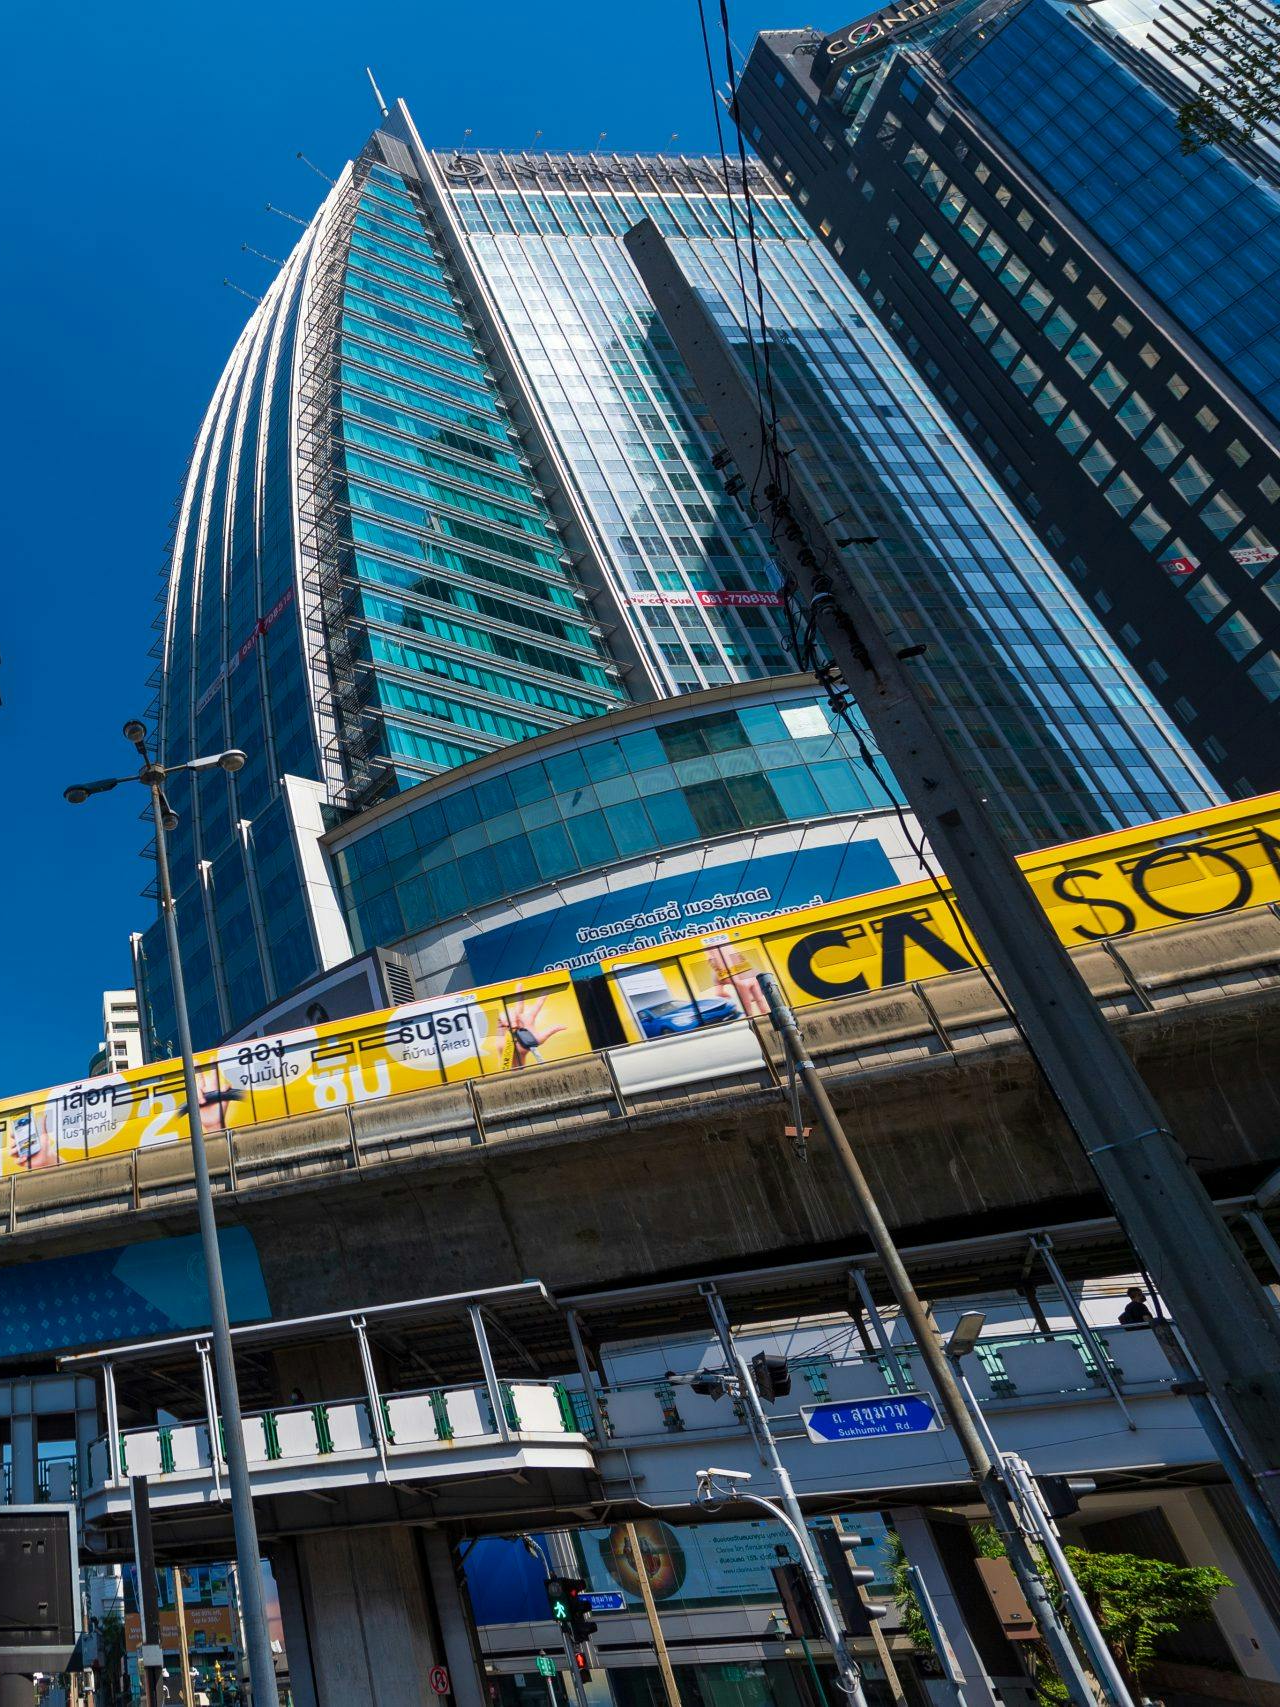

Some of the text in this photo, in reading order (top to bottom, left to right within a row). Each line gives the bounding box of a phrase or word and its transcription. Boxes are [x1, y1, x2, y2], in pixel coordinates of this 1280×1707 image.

[827, 0, 938, 54] CONTI
[238, 1040, 285, 1065] ลอง
[63, 1085, 116, 1111] เลือก
[832, 1401, 908, 1427] ถ. สุขุมวิท
[838, 1422, 913, 1437] Sukhumvit Rd.
